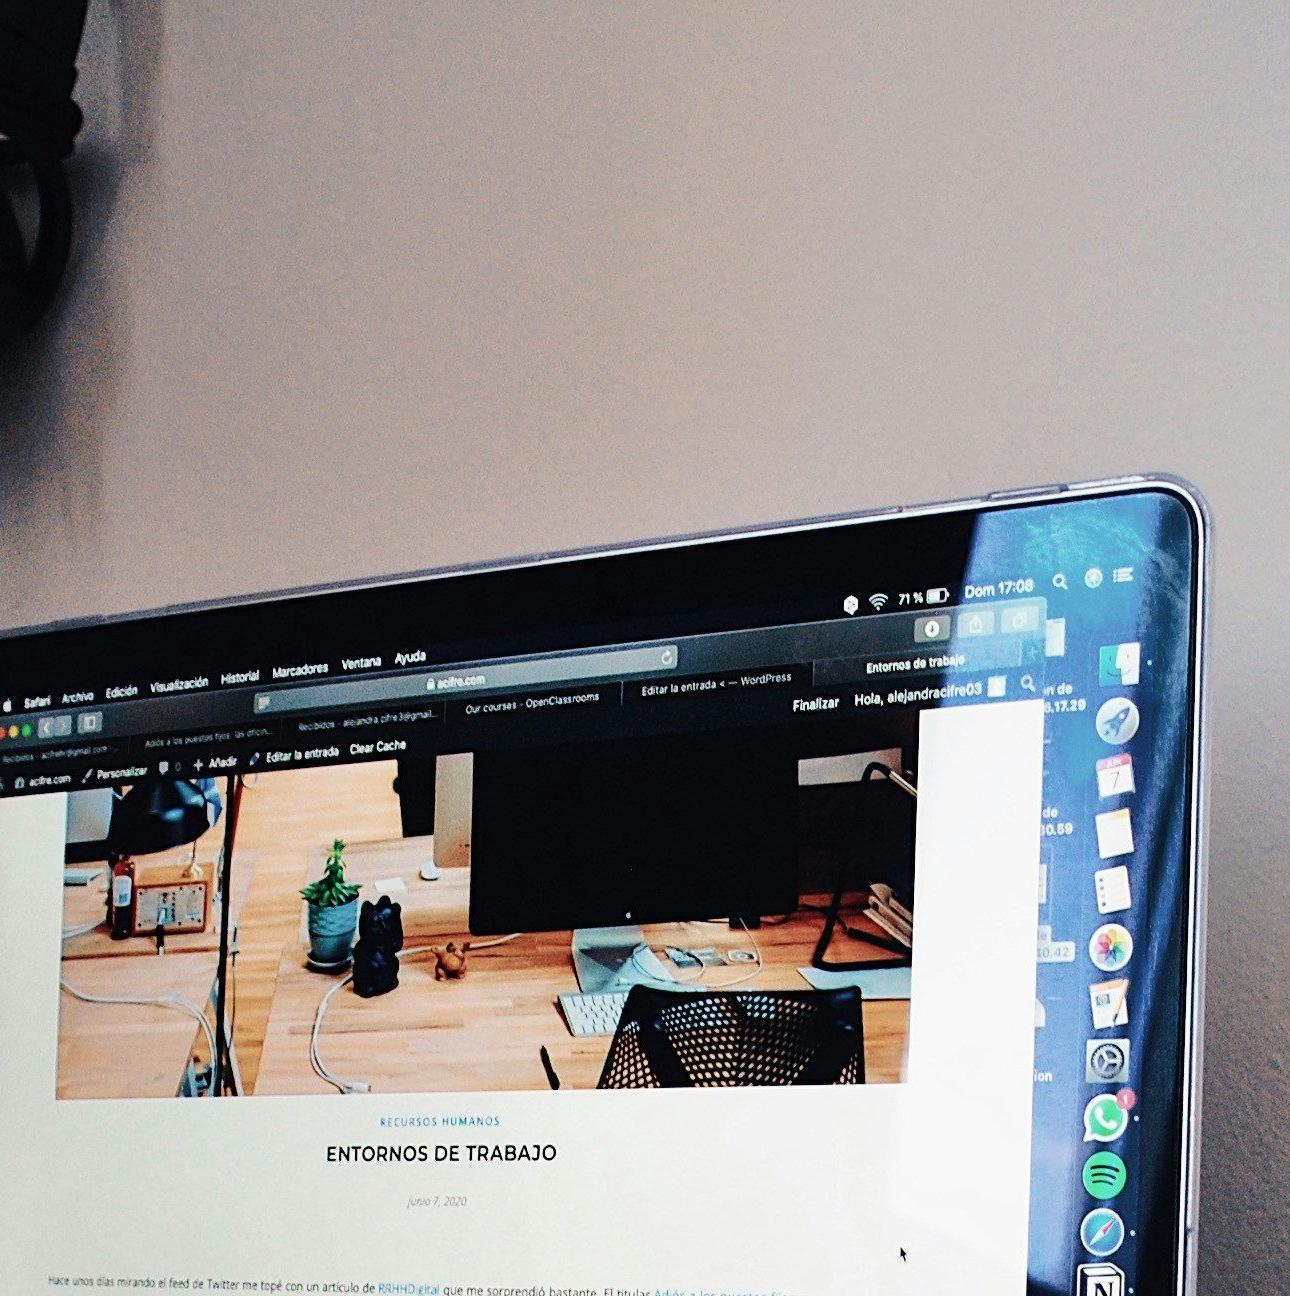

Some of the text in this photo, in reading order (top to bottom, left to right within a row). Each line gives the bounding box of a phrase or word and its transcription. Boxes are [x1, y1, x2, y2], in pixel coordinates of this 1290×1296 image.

[964, 578, 1034, 599] Dom 17:08
[898, 592, 924, 605] 71 %
[866, 654, 965, 674] Entornos de trabajo
[24, 650, 426, 709] Safari Archivo Edición Visualización Historial Marcadores Ventana Ayuda
[437, 674, 485, 688] acifre.com
[641, 684, 668, 696] Editar
[670, 682, 679, 693] la
[681, 680, 717, 692] entrada
[741, 672, 791, 686] WordPress
[1057, 682, 1072, 695] de
[465, 692, 599, 714] Our courses OpenClassrooms
[299, 721, 335, 731] Recibidos
[29, 775, 71, 787] acifre.com
[97, 766, 147, 780] Personalizar
[209, 755, 237, 768] Añadir
[266, 750, 291, 763] Editar
[294, 749, 303, 761] la
[304, 746, 339, 760] entrada
[350, 742, 374, 755] Clear
[376, 740, 406, 752] Cache
[793, 697, 840, 713] Finalizar
[854, 692, 884, 707] Hola,
[887, 683, 982, 704] alejandracifre03
[1110, 771, 1120, 789] 7
[1042, 806, 1058, 819] de
[380, 1116, 501, 1128] RECURSOS HUMANOS
[326, 1144, 557, 1162] ENTORNOS DE TRABAJO
[407, 1196, 467, 1209] junio 7, 2020
[206, 1279, 240, 1289] Twitter
[260, 1281, 283, 1292] topé
[285, 1283, 304, 1291] con
[321, 1282, 360, 1293] artículo
[377, 1283, 440, 1296] RRHHDigital
[442, 1287, 463, 1296] que
[466, 1288, 484, 1296] me
